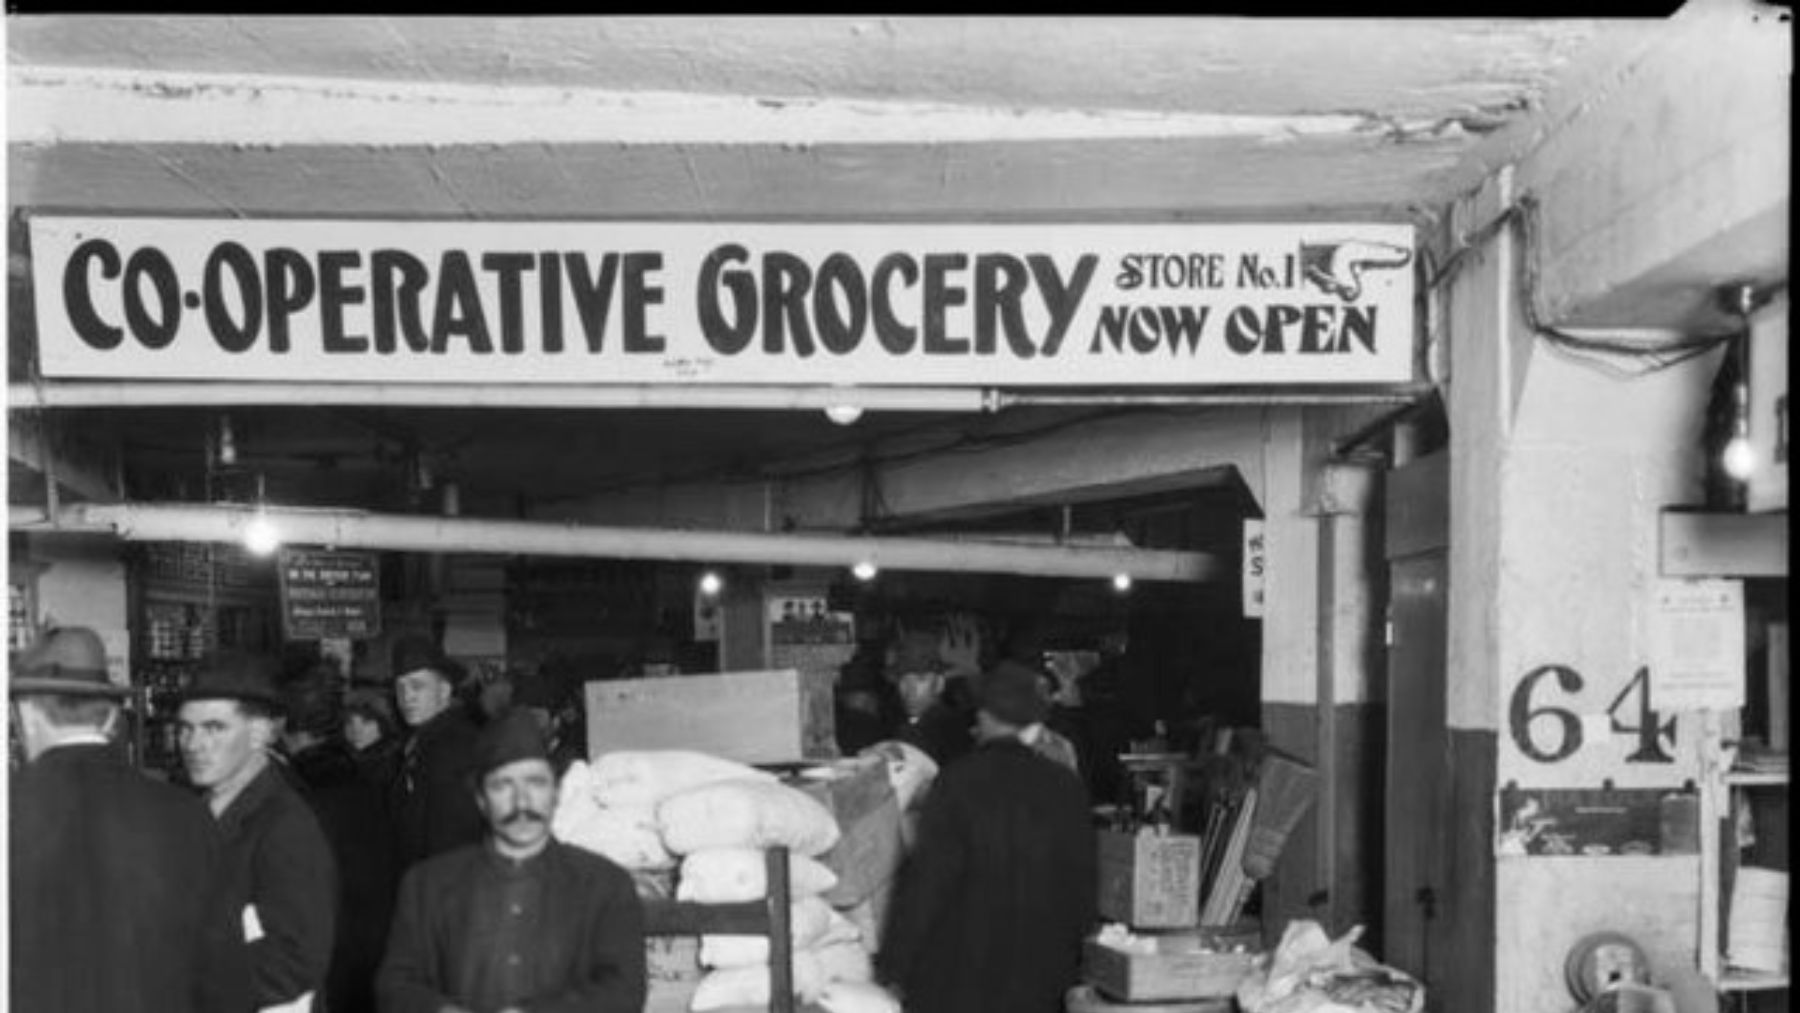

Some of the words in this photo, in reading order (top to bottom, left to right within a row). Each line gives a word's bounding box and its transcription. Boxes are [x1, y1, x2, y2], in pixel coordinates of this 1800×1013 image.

[698, 245, 1099, 358] GROCERY
[1115, 253, 1224, 290] STORE
[1089, 305, 1211, 356] NOW
[1225, 304, 1378, 355] OPEN
[1509, 664, 1678, 764] 64
